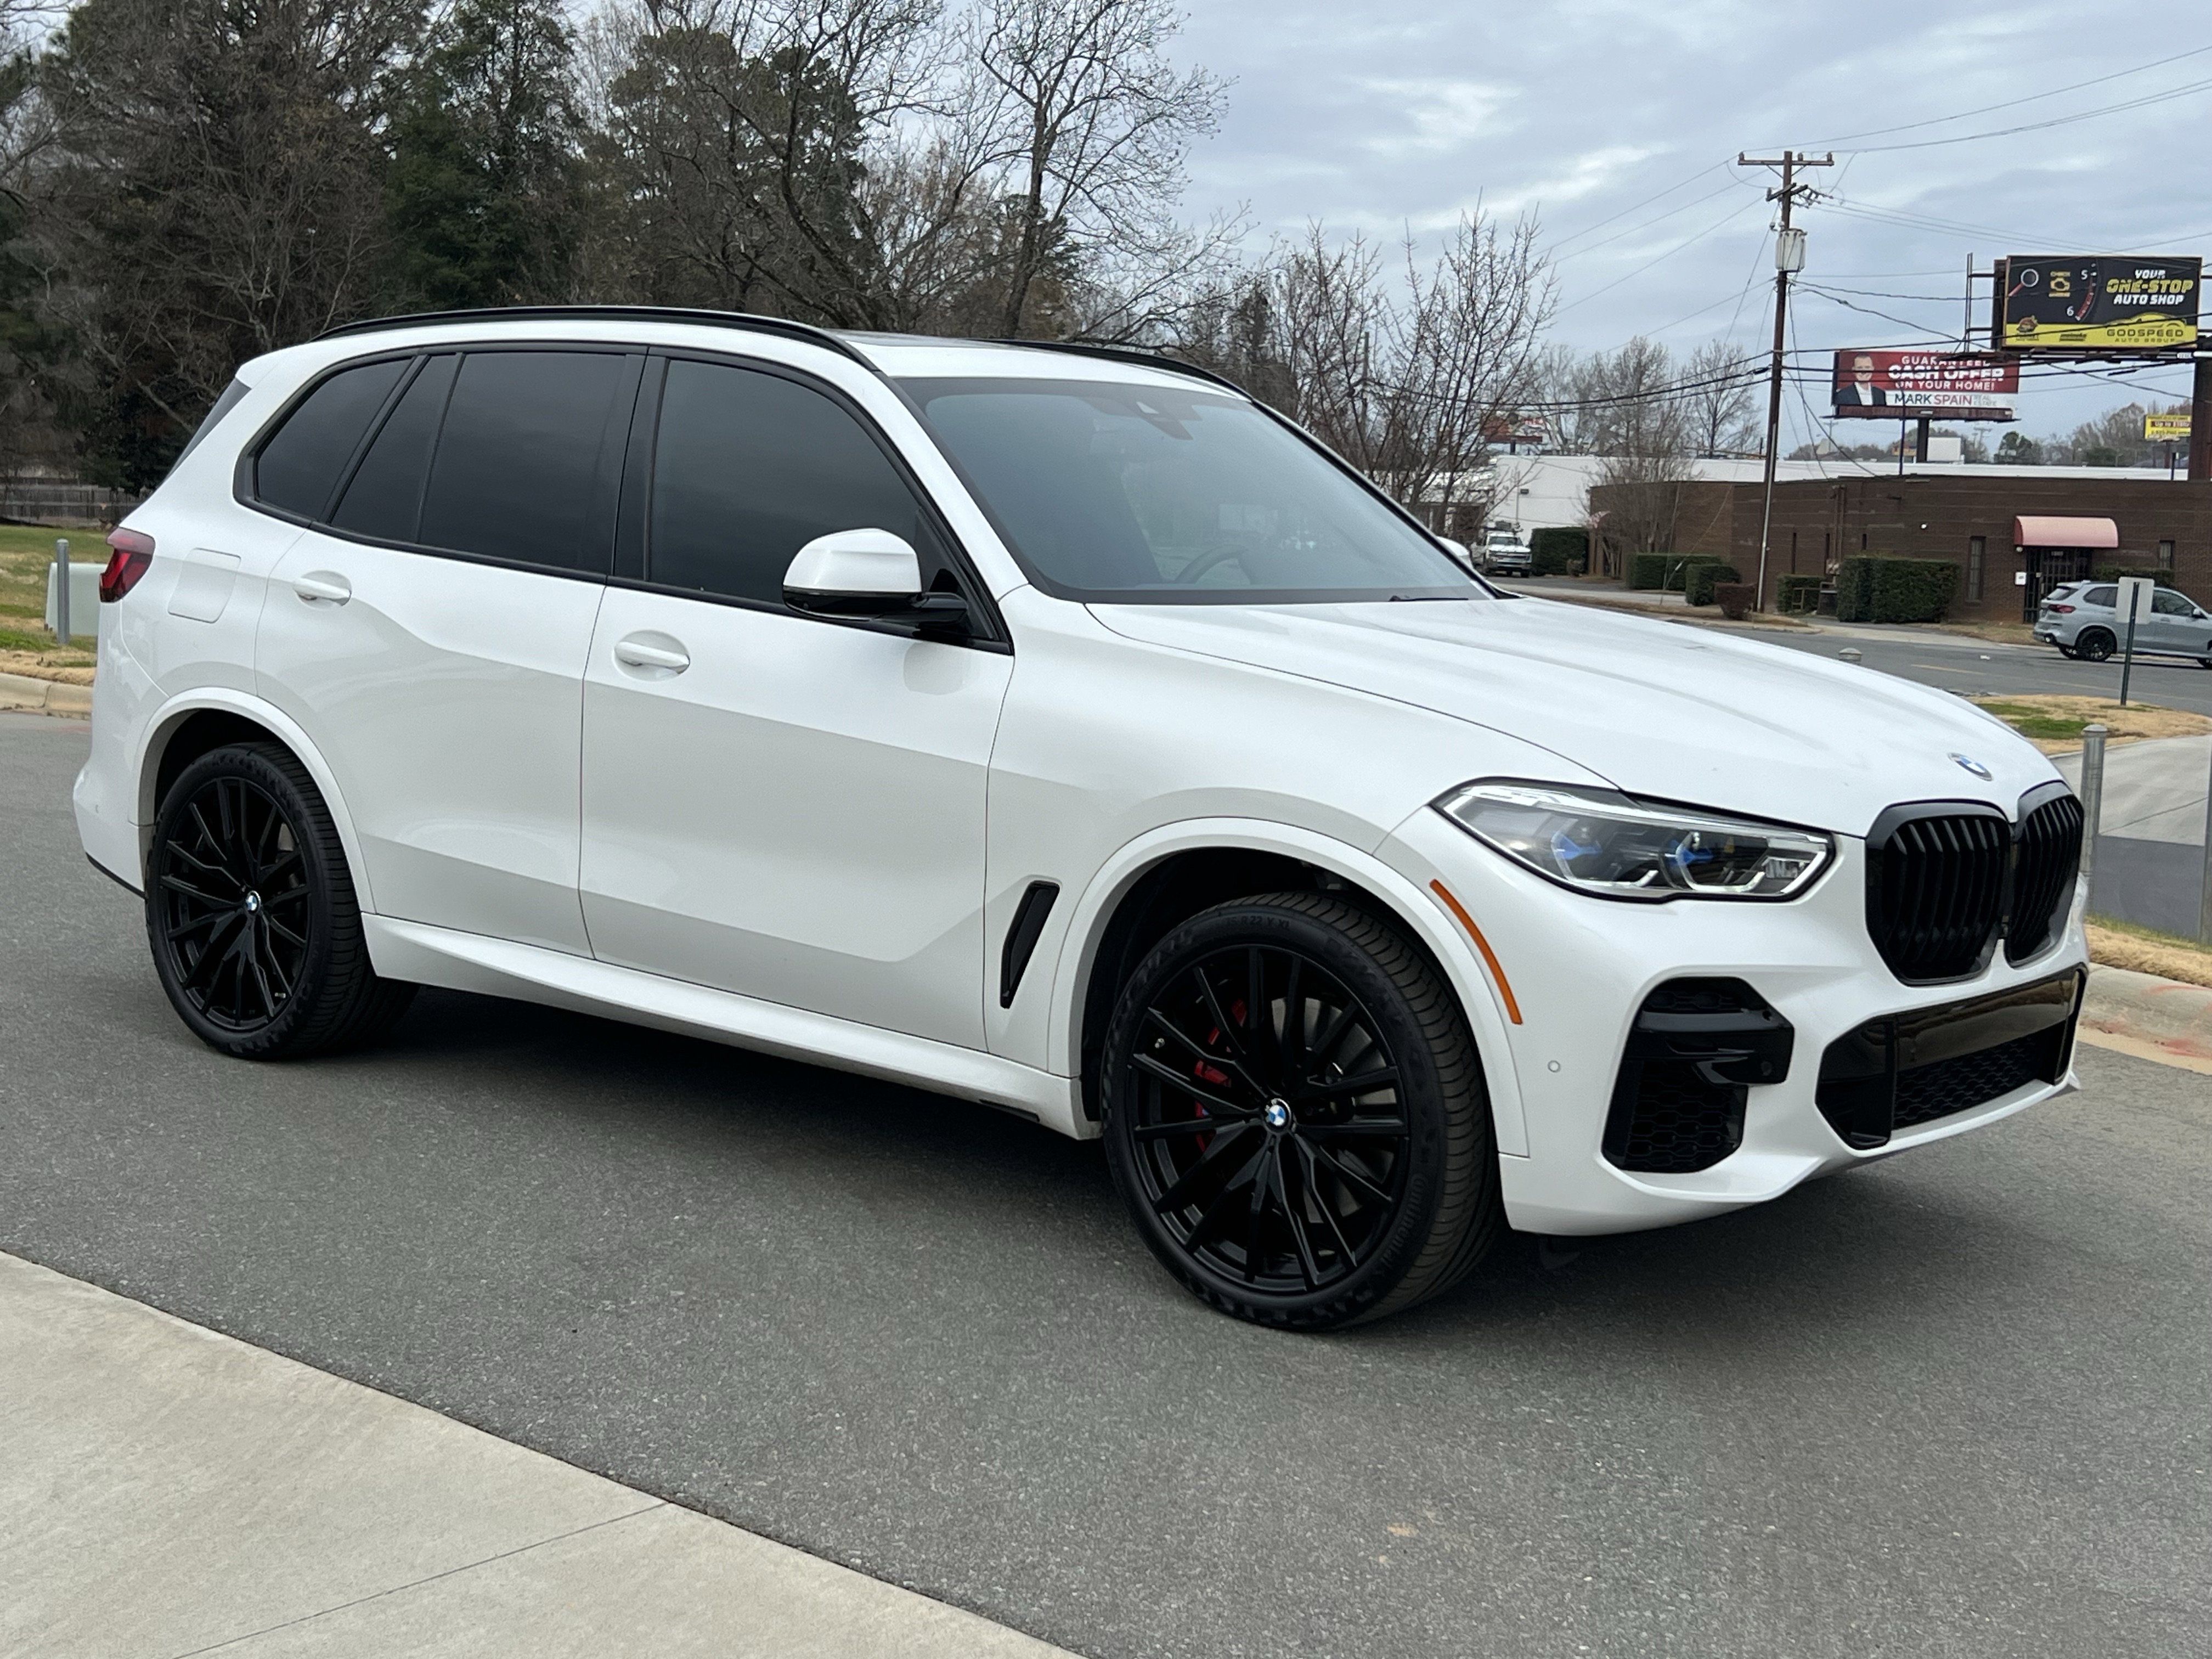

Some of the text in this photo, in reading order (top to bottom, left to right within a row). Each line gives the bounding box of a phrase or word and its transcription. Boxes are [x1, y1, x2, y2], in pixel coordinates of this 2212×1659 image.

[2081, 269, 2088, 280] 5
[2135, 269, 2166, 279] YOUR
[2106, 279, 2193, 294] ONE-STOP
[2113, 294, 2184, 305] AUTO SHOP
[2067, 306, 2074, 317] 6
[2107, 329, 2183, 337] GODSPEED
[1888, 364, 2005, 382] CASH OFFER
[1918, 381, 1951, 390] YOUR
[1955, 381, 1995, 391] HOME!
[1894, 393, 1932, 405] MARK
[1934, 394, 1972, 406] SPAIN
